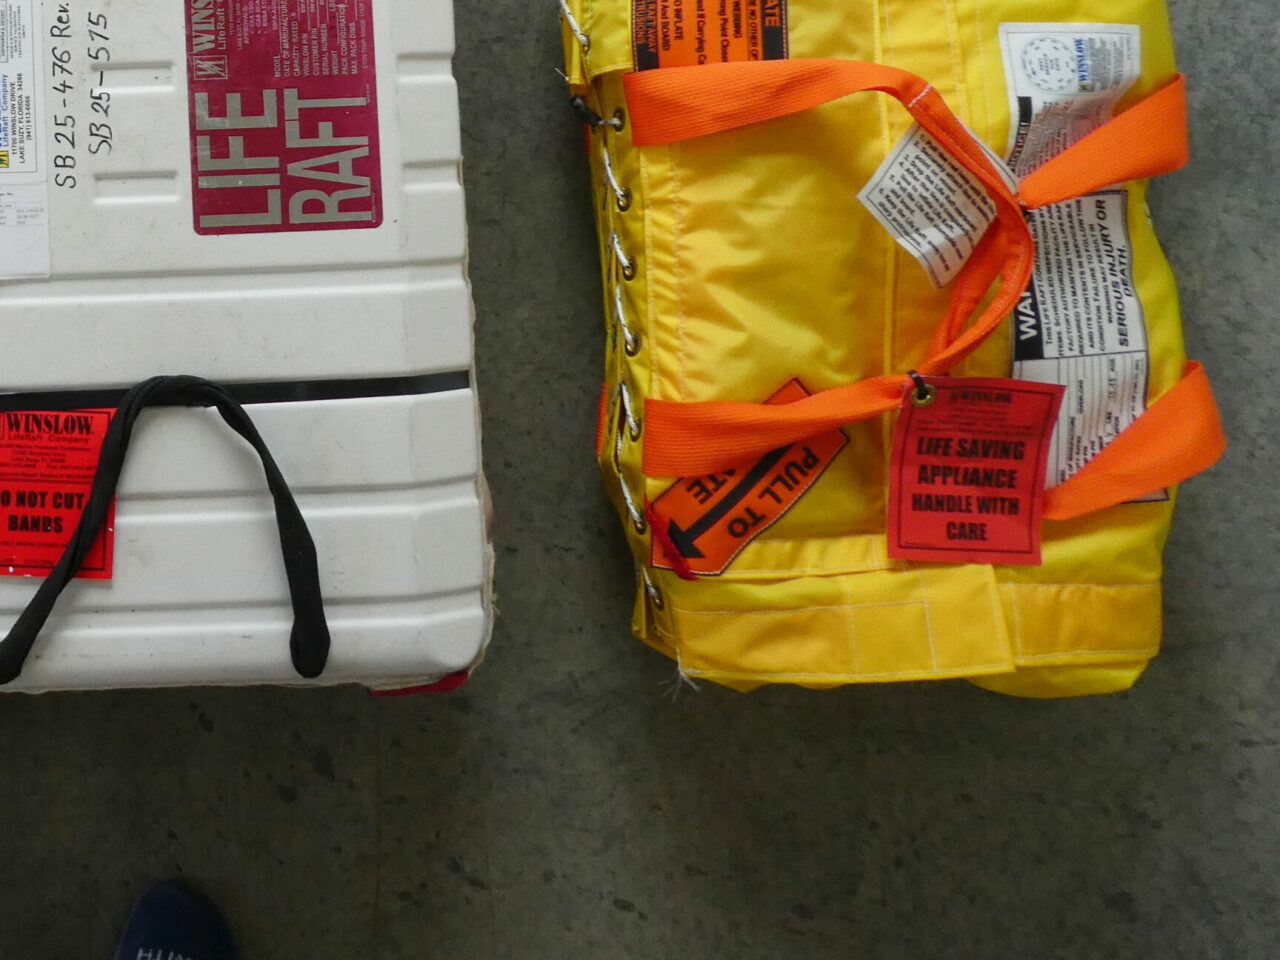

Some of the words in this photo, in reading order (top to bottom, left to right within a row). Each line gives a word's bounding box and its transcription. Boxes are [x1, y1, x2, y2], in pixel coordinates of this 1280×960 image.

[50, 2, 72, 37] Rev.
[280, 0, 288, 48] MANUFACTURE
[733, 0, 741, 38] WEBBING
[749, 9, 757, 20] NO
[320, 23, 328, 51] NUMBER
[749, 22, 757, 47] OTHER
[281, 49, 288, 57] OF
[311, 40, 319, 75] CUSTOMER
[1072, 37, 1088, 82] WINSLOW
[1, 74, 9, 110] Company
[1, 116, 9, 146] LifeRaft
[194, 88, 281, 227] LIFE
[284, 88, 372, 223] RAFT
[1094, 198, 1108, 220] OR
[1064, 202, 1082, 259] SERVICEABLE
[1097, 221, 1118, 277] INJURY
[1077, 260, 1084, 268] IN
[1078, 269, 1091, 315] CONTENTS
[1085, 316, 1093, 329] ITS
[1110, 279, 1129, 347] SERIOUS
[1086, 330, 1095, 348] AND
[5, 412, 93, 435] WINSLOW
[8, 433, 42, 441] LifeRaft
[48, 434, 89, 444] Company
[916, 435, 953, 457] LIFE
[956, 436, 1025, 462] SAVING
[759, 449, 821, 506] PULL
[917, 463, 1017, 490] APPLIANCE
[16, 490, 47, 507] NOT
[53, 491, 84, 509] CUT
[911, 491, 973, 515] HANDLE
[975, 495, 1019, 516] WITH
[8, 514, 63, 532] BANDS
[727, 505, 766, 539] TO
[945, 520, 988, 542] CARE
